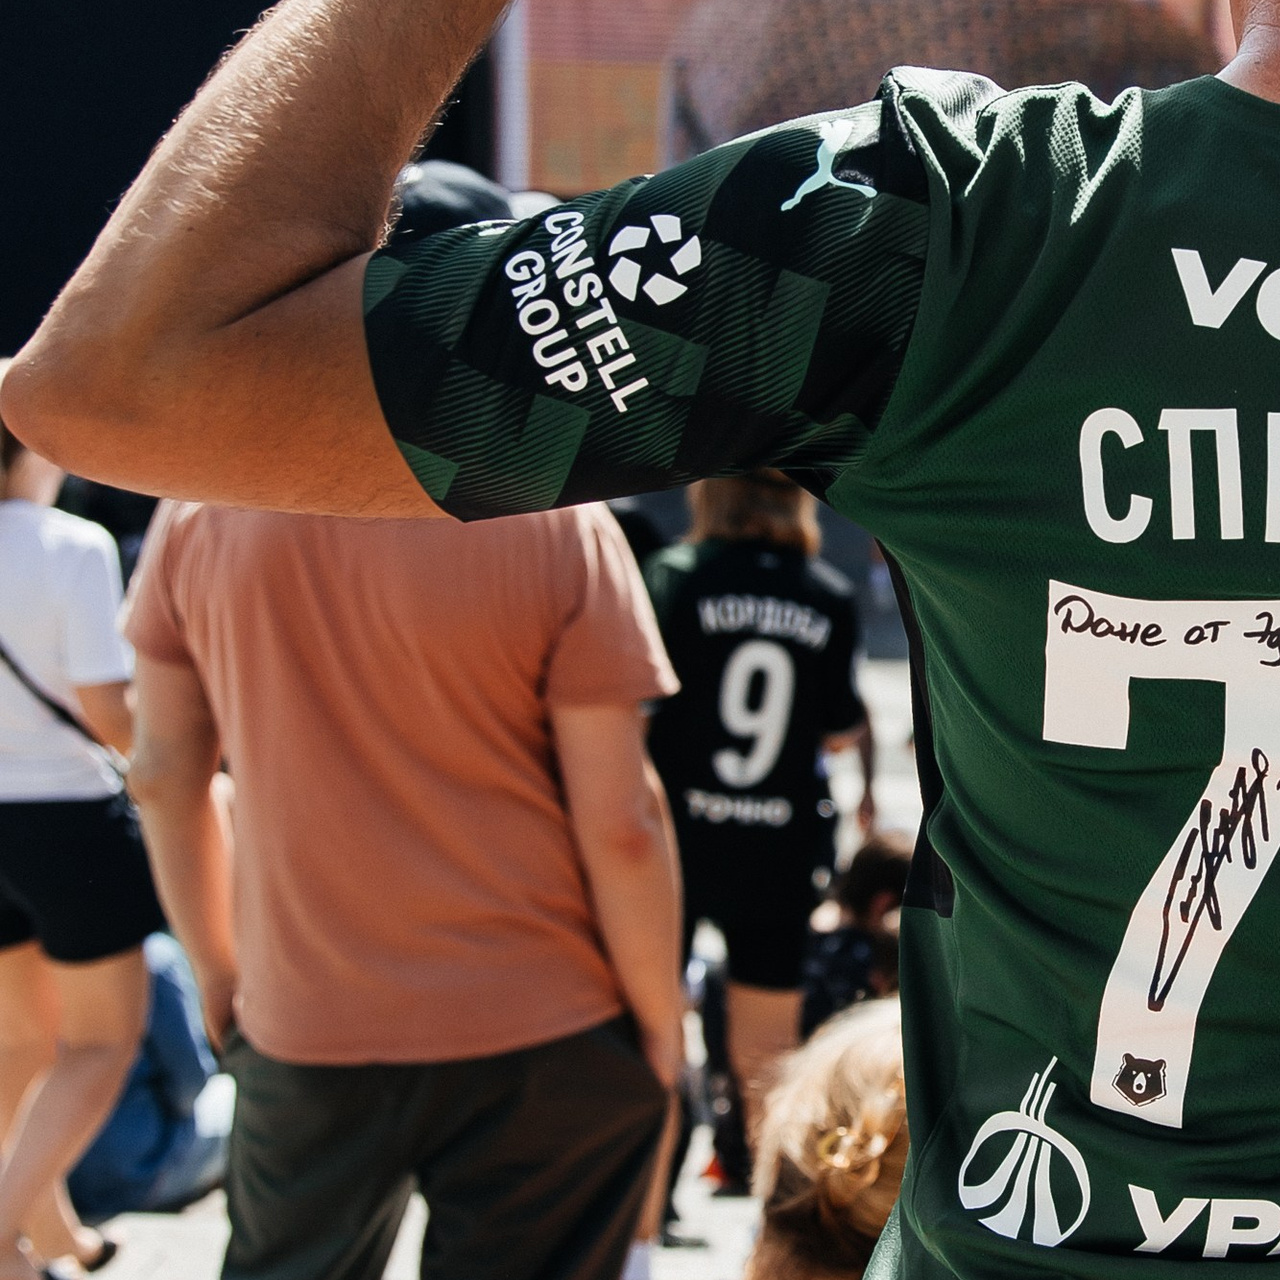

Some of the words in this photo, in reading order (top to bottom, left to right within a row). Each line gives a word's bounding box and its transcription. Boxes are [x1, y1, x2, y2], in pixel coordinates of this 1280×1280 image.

[505, 250, 588, 392] GROUP
[545, 211, 649, 413] CONSTELL
[712, 637, 797, 789] 9
